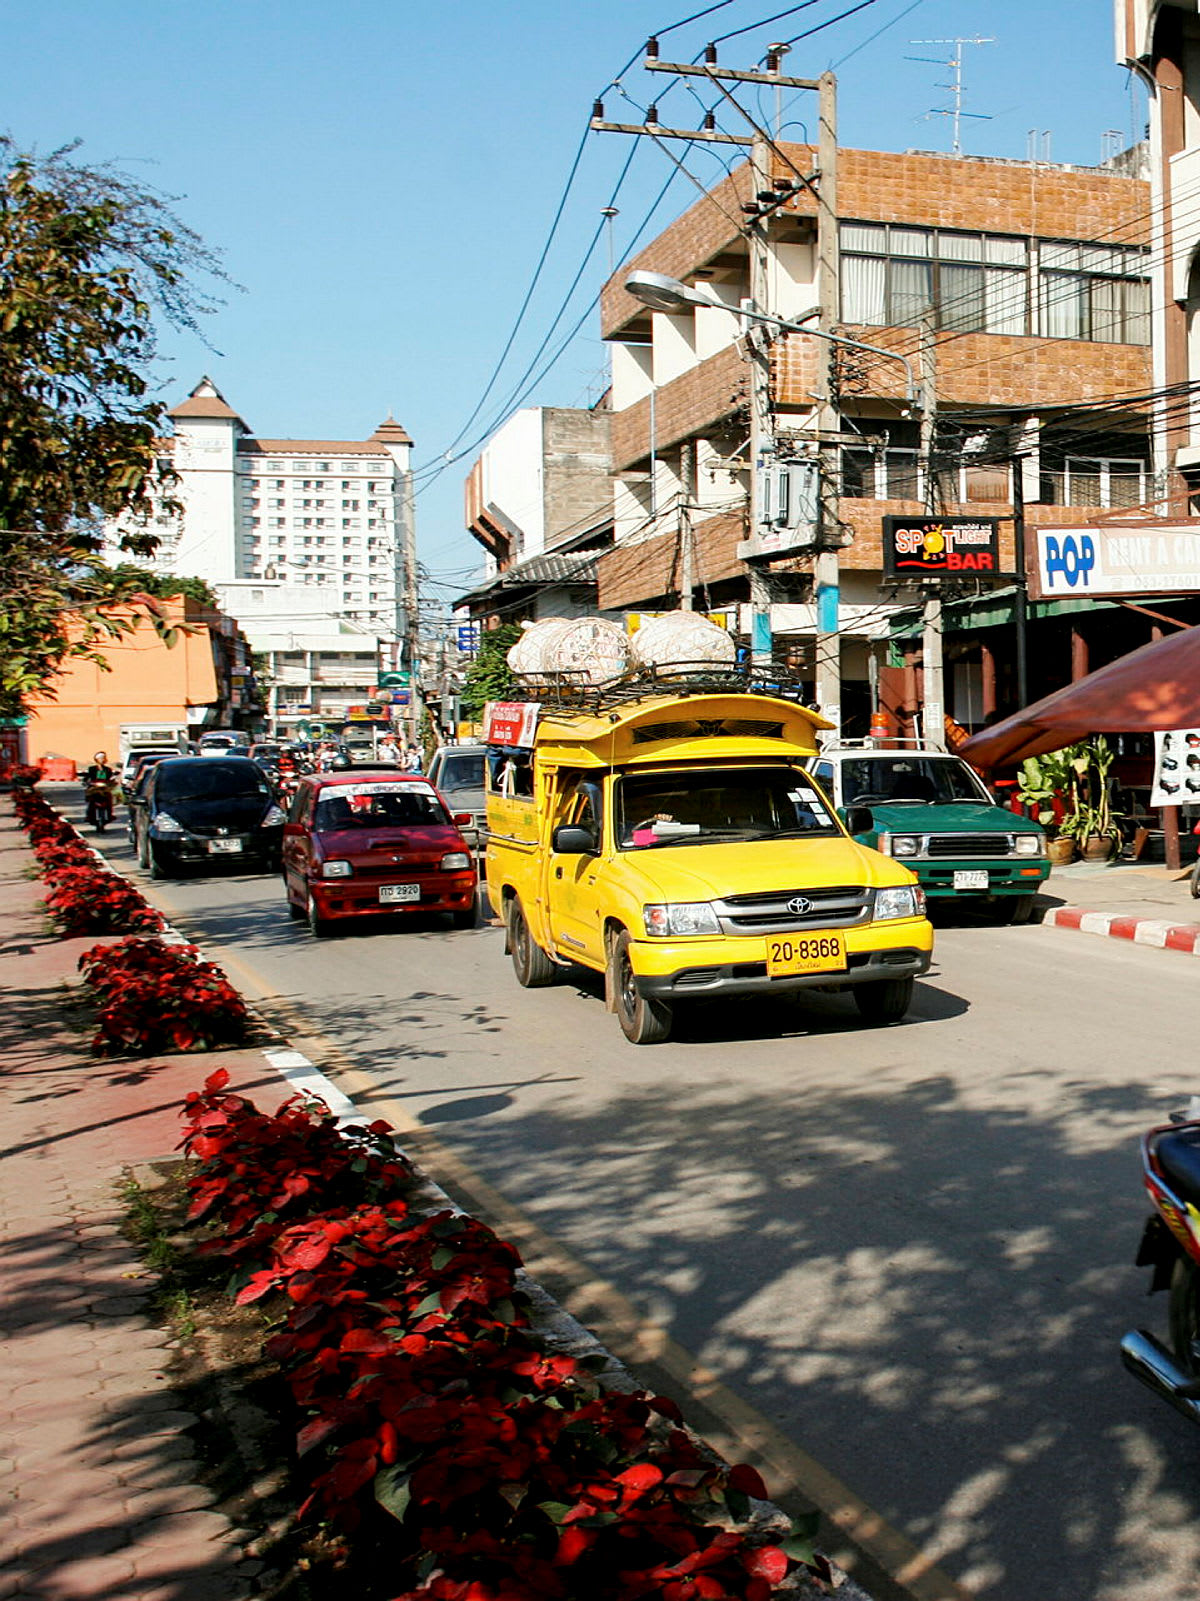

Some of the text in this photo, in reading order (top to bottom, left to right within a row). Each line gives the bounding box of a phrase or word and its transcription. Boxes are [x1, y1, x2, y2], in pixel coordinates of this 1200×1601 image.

[945, 552, 994, 571] BAR
[1045, 535, 1095, 588] POP
[772, 938, 840, 962] 20-8368
